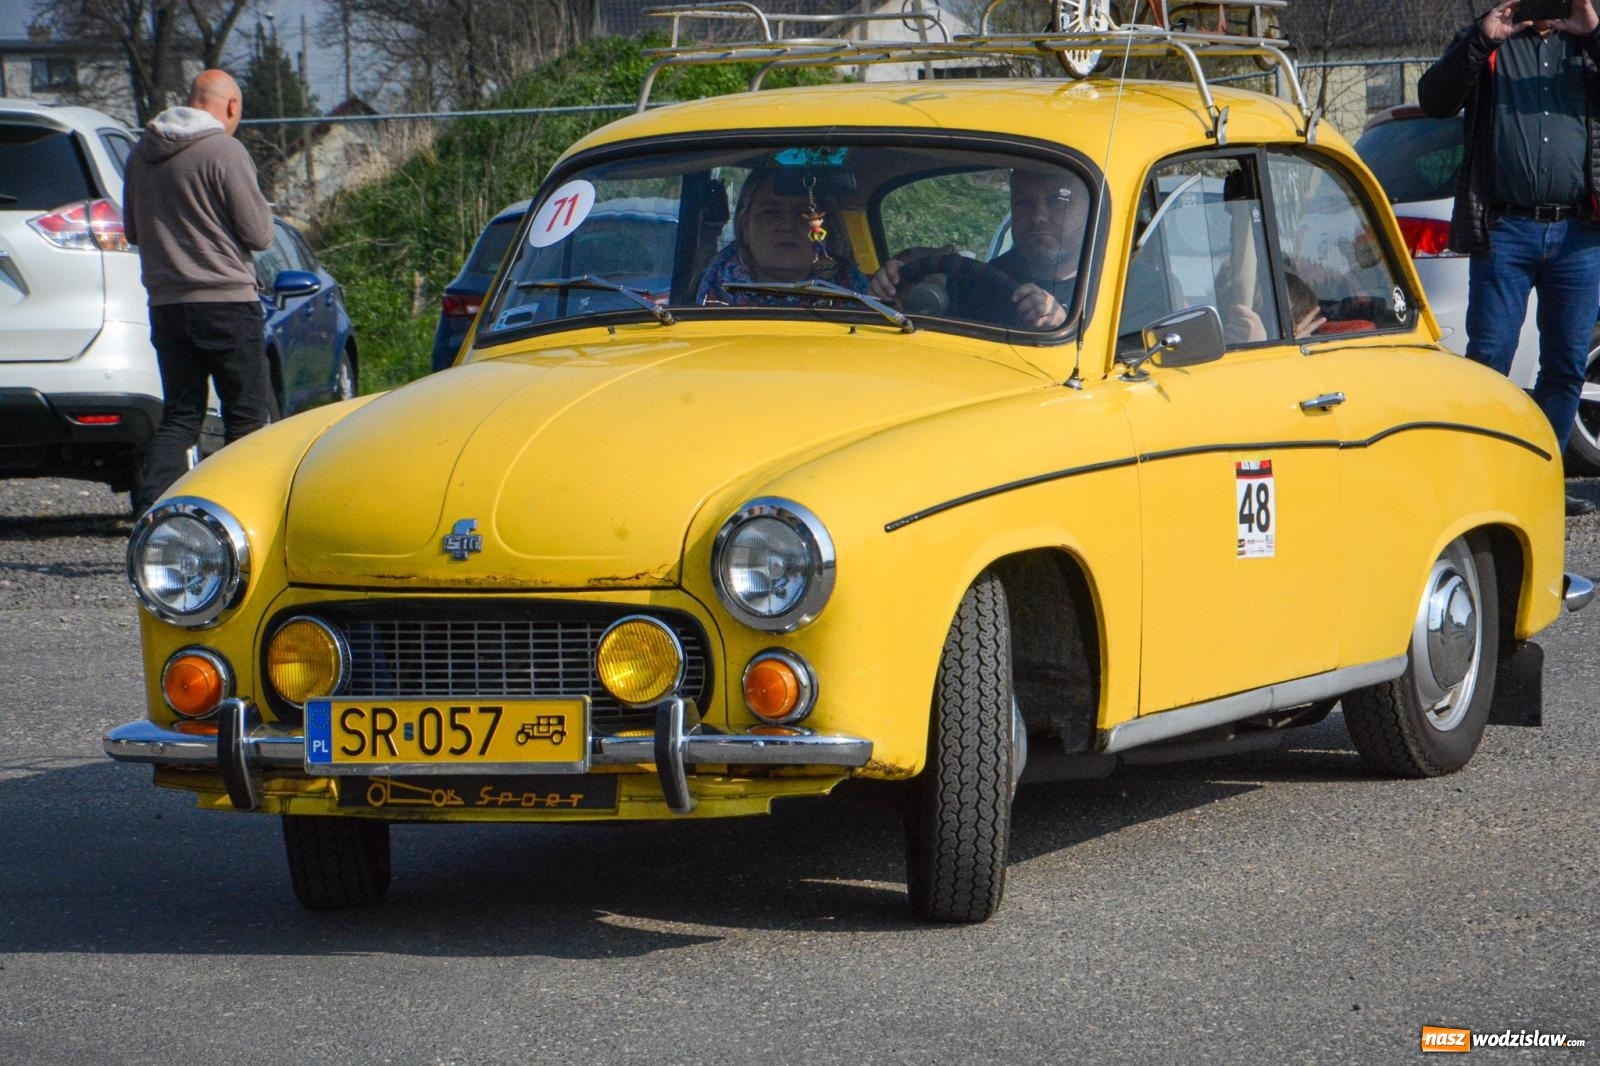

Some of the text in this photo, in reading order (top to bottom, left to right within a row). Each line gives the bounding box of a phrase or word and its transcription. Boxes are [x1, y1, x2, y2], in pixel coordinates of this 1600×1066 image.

[545, 193, 580, 233] 71
[1239, 482, 1270, 533] 48
[313, 740, 329, 753] PL
[340, 706, 504, 757] SR 057
